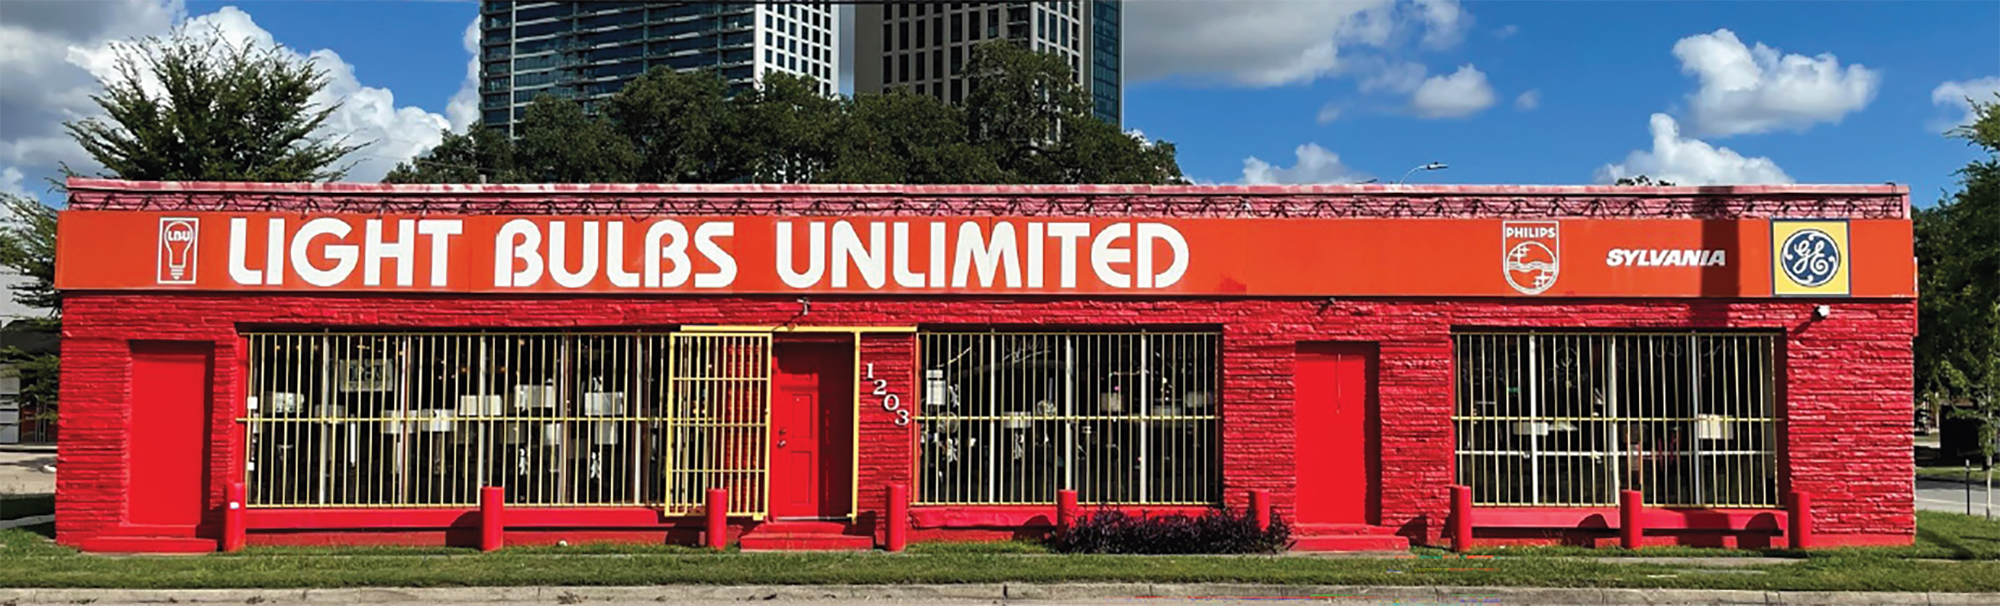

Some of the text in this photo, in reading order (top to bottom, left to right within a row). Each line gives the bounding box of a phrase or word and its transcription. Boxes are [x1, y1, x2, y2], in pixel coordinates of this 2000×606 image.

[168, 230, 190, 241] LBU
[1506, 227, 1556, 238] PHILIPS
[229, 217, 1190, 288] LIGHT BULBS UNLIMITED
[1606, 249, 1726, 267] SYLVANIA
[867, 363, 909, 426] 1203
